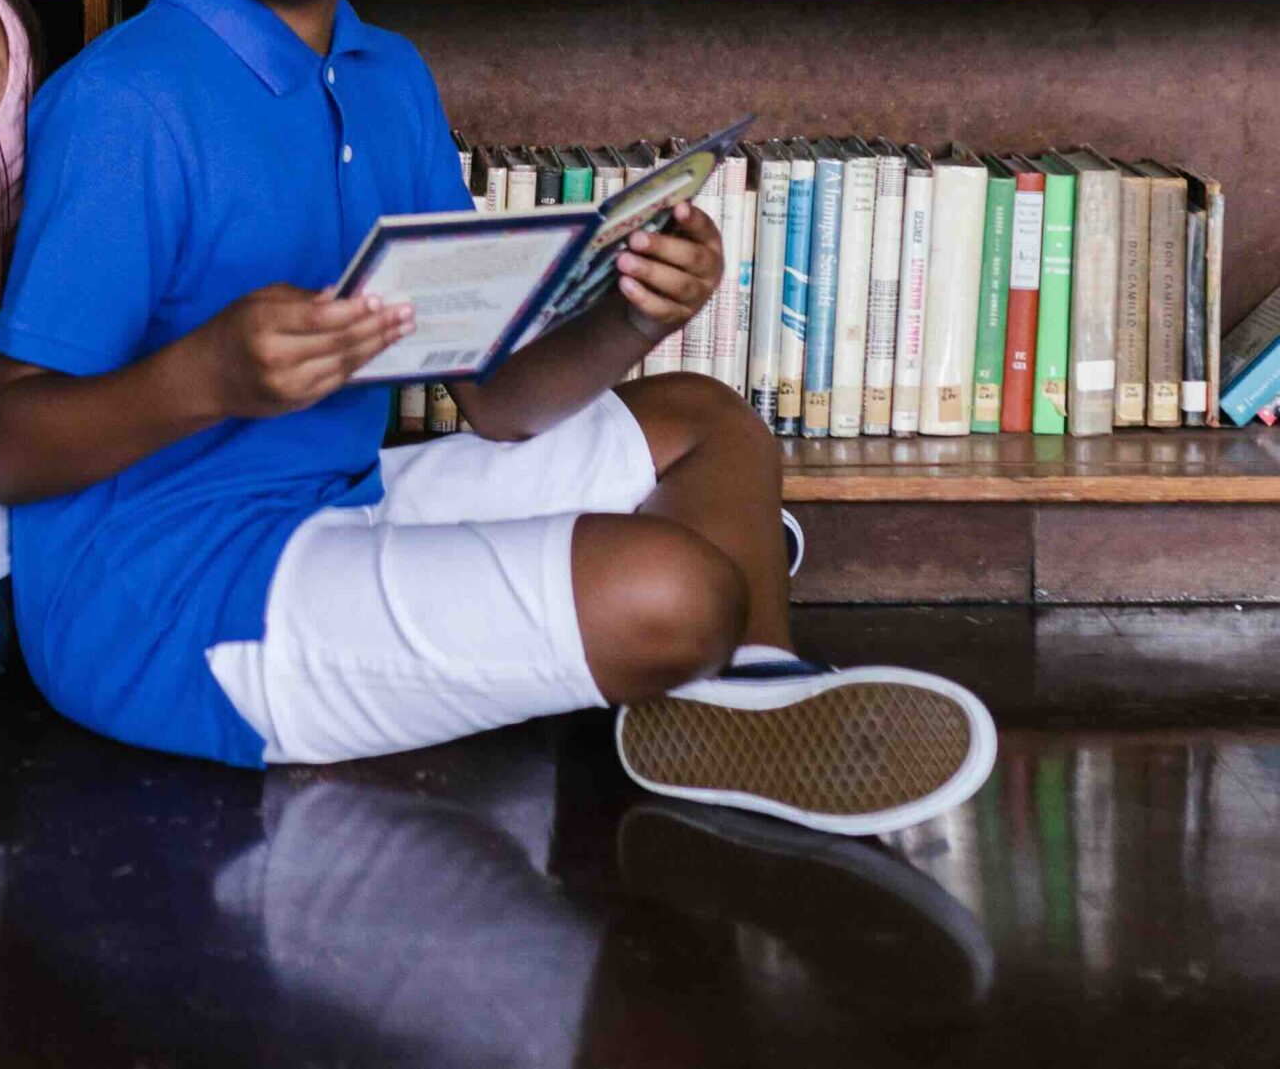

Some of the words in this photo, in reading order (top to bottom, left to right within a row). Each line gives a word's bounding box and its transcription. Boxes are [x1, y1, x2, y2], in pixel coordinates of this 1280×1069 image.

[826, 169, 840, 182] A
[821, 188, 840, 247] Trumpet
[819, 253, 836, 307] Sounds
[1127, 240, 1138, 267] DON
[1164, 241, 1175, 268] DON
[1127, 273, 1137, 327] CAMILLO
[1164, 274, 1174, 329] CAMILLO
